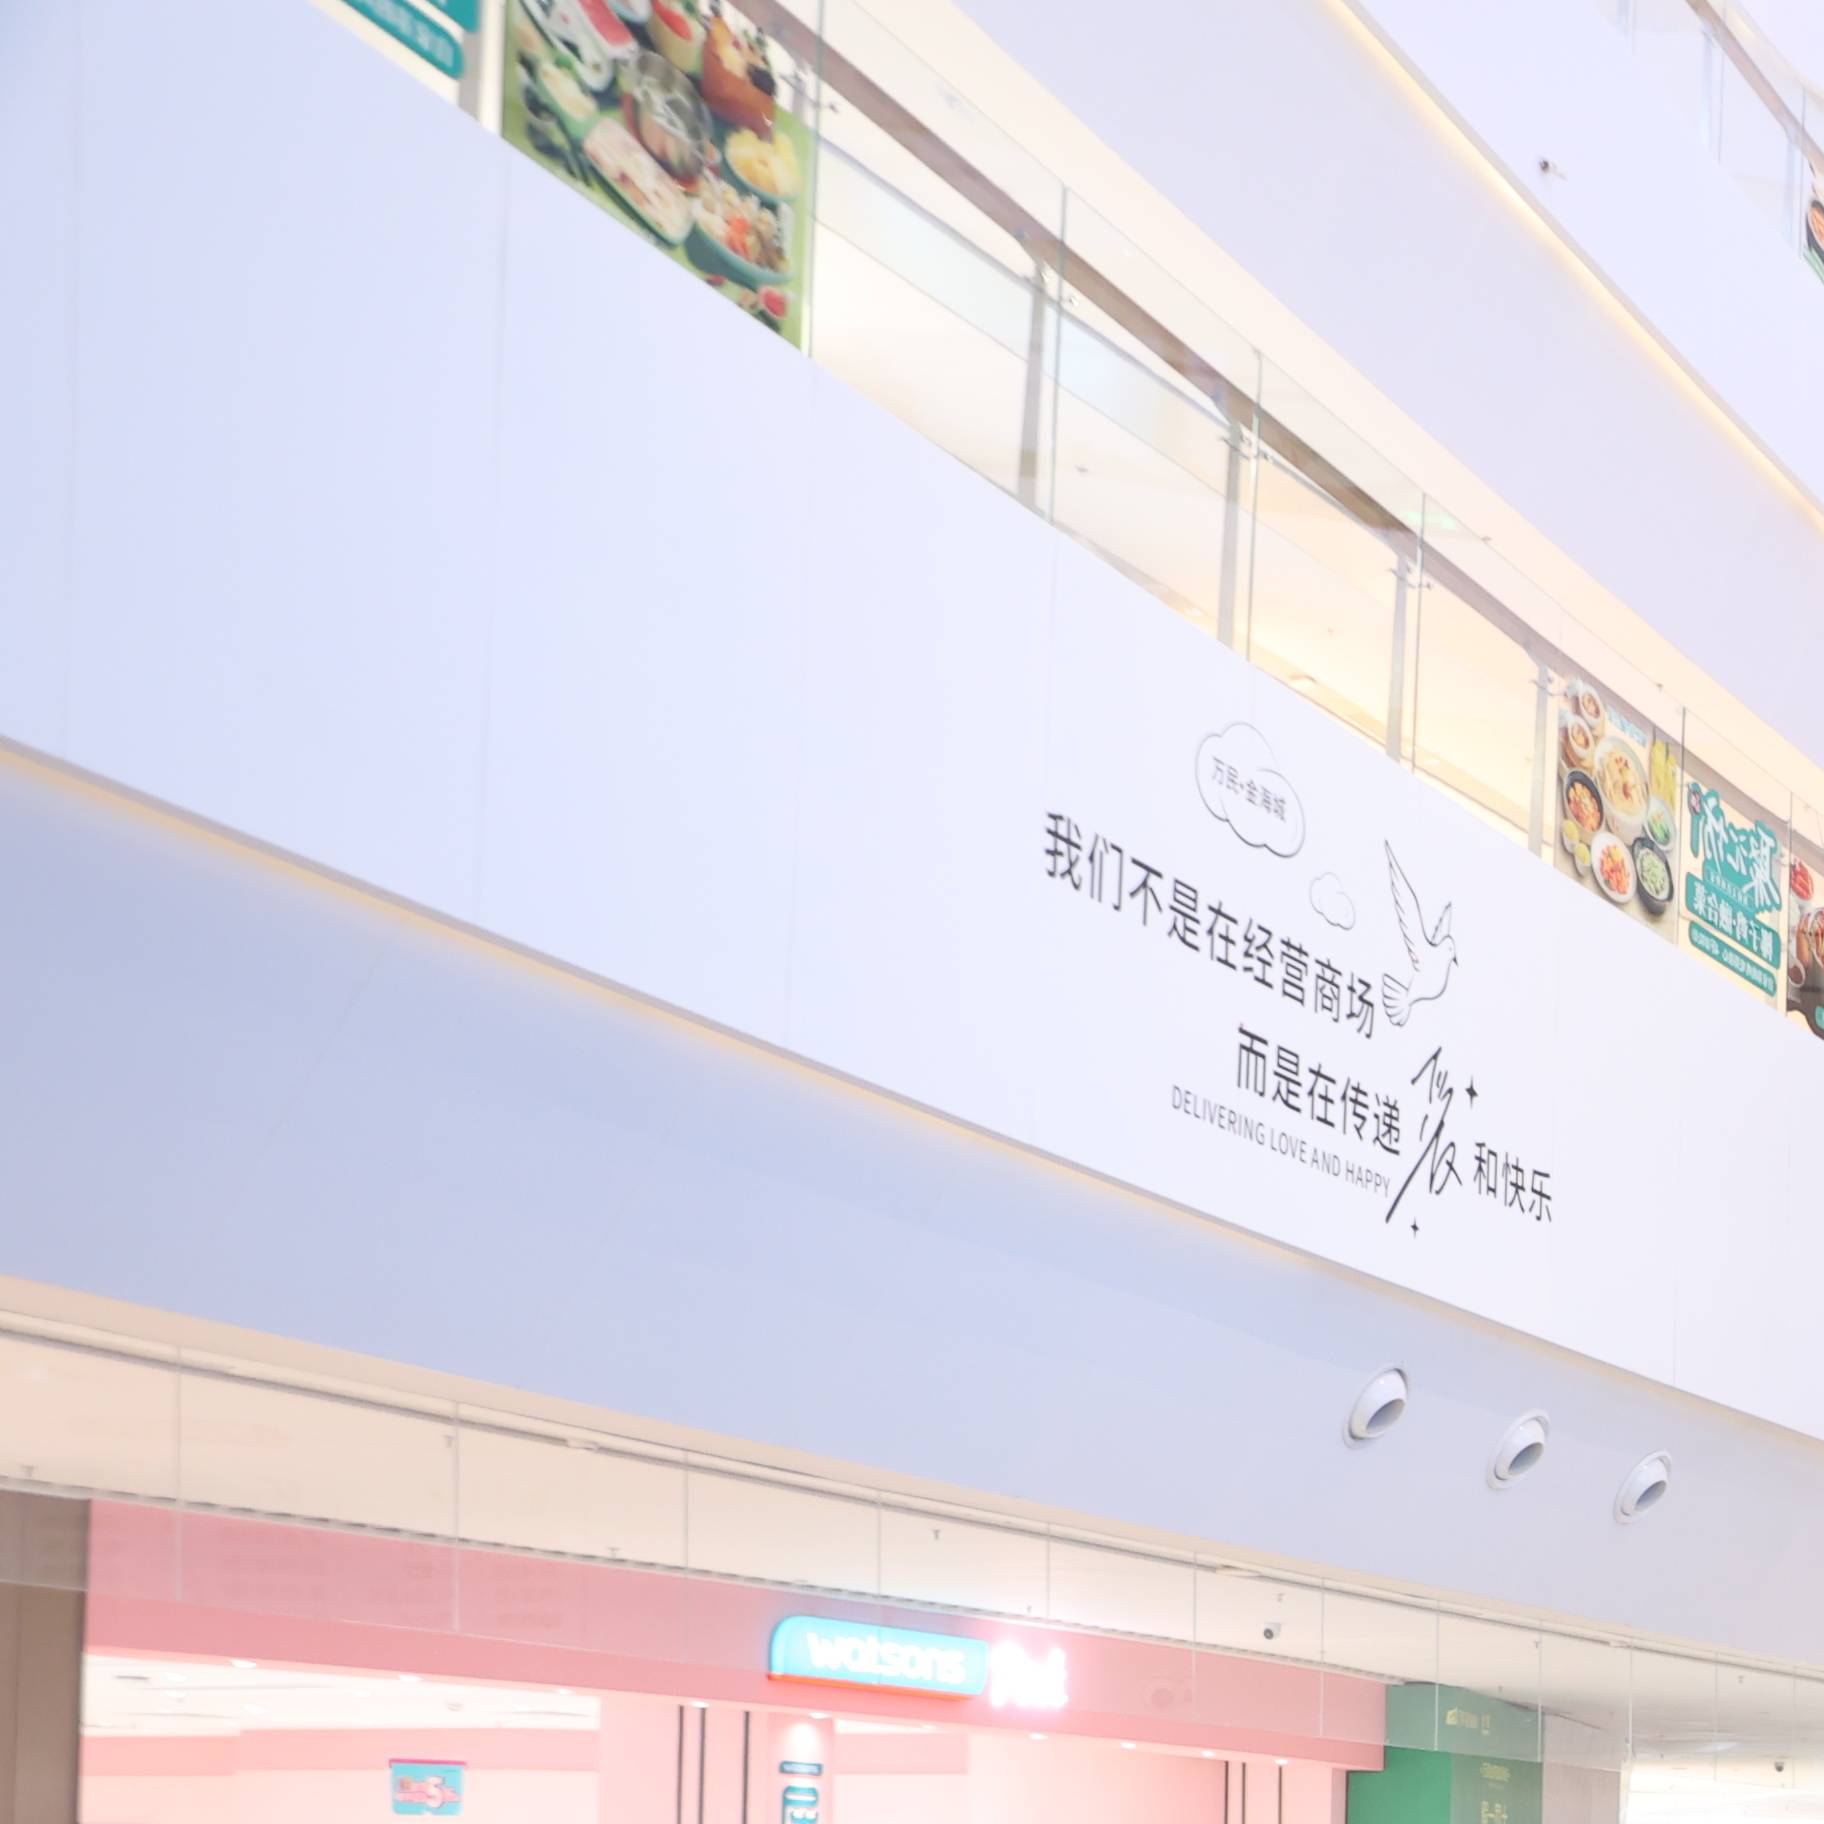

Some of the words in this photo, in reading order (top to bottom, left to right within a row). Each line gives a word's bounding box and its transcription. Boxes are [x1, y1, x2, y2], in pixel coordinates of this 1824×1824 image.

[1044, 811, 1376, 1040] 我们不是在经营商场
[1171, 1083, 1266, 1147] DELIVERING
[1269, 1129, 1309, 1165] LOVE
[1311, 1147, 1342, 1179] AND
[1345, 1161, 1391, 1199] HAPPY
[1237, 1024, 1402, 1157] 而是在传递
[1473, 1141, 1553, 1223] 和快乐
